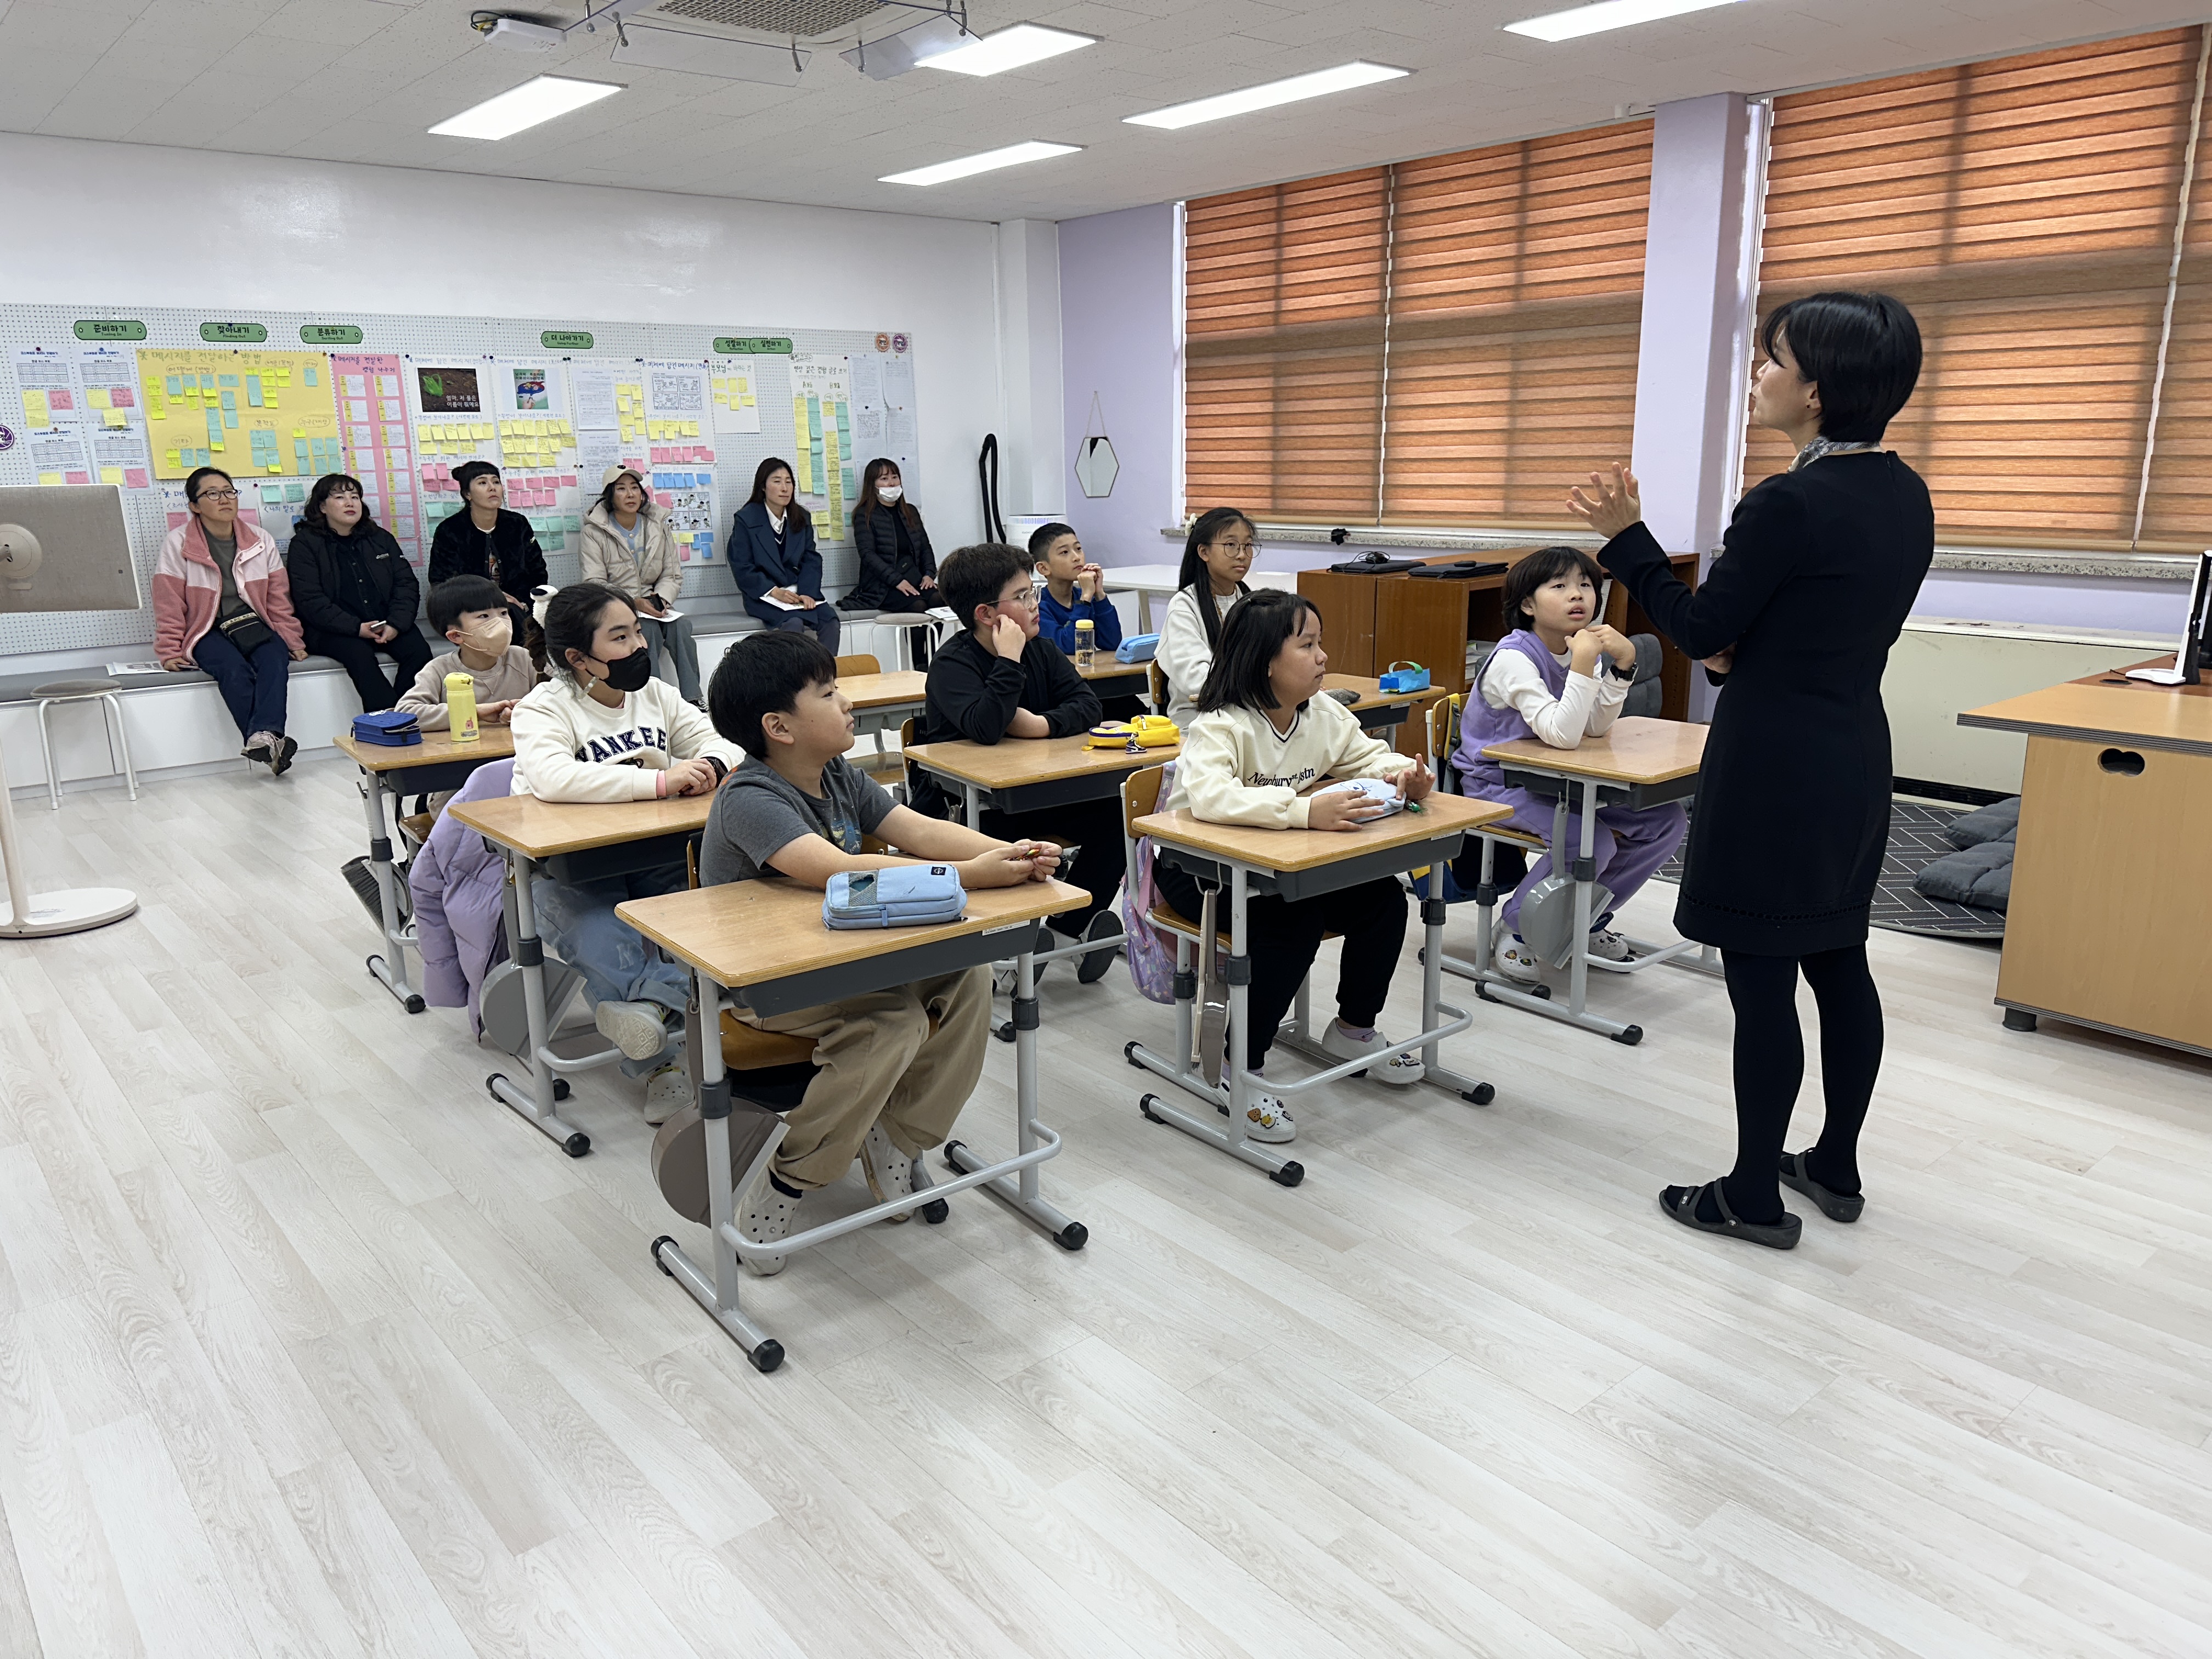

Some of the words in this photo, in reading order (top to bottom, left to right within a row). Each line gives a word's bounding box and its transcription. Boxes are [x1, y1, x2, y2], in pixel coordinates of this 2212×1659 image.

[93, 324, 127, 333] 준비하기
[151, 351, 191, 363] 메시지를
[198, 352, 235, 363] 전달하는
[338, 357, 360, 365] 메시지를
[364, 357, 383, 365] 전달한
[711, 364, 726, 374] 부모님
[283, 505, 295, 514] 말로
[1297, 768, 1316, 785] stn
